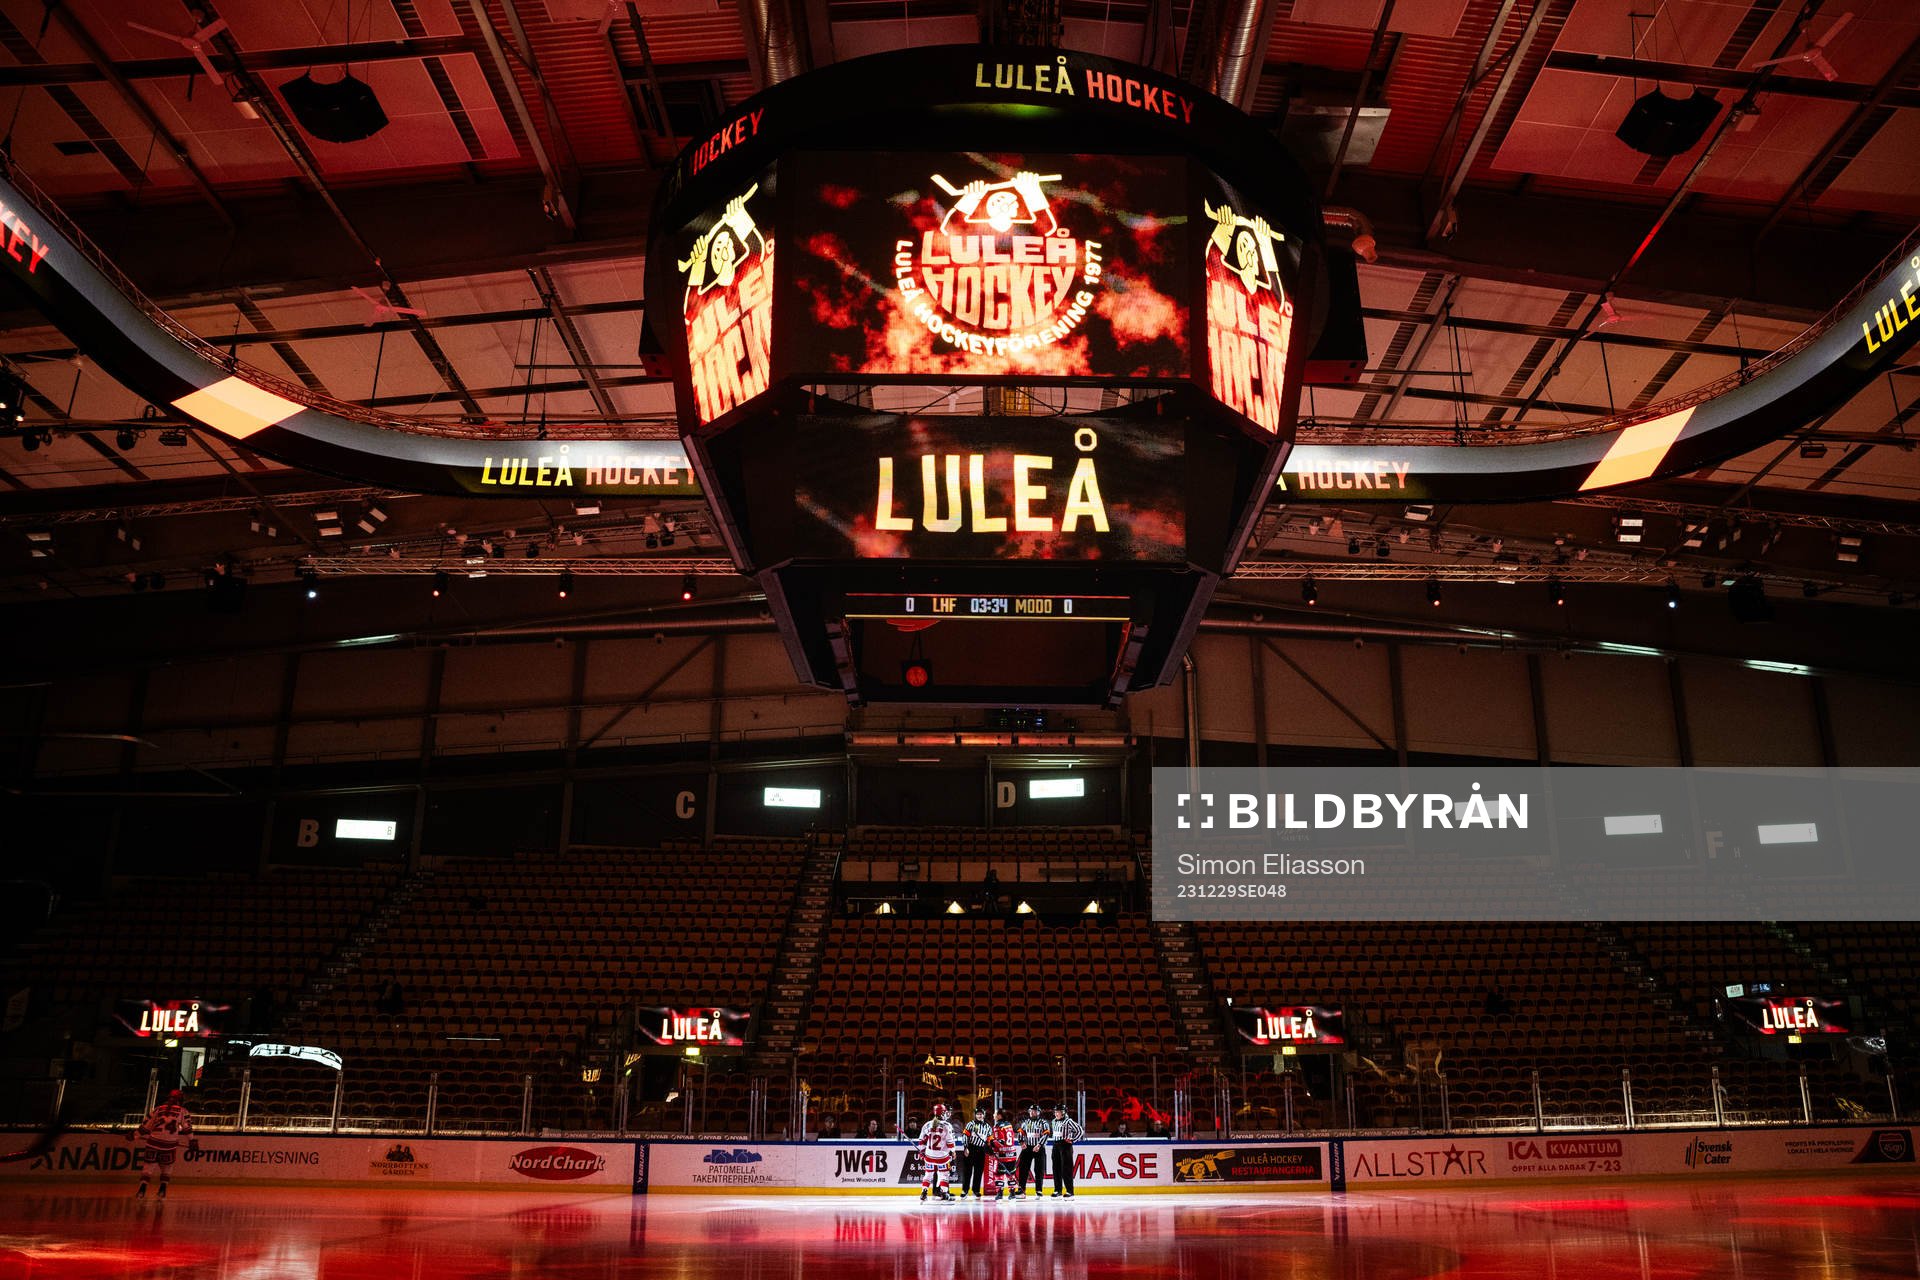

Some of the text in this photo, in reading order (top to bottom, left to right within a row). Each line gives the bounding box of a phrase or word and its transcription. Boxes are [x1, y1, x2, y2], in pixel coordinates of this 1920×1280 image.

[976, 56, 1195, 124] LULEÅ HOCKEY
[922, 228, 1077, 264] LULEÅ
[894, 240, 925, 302] LULEÅ
[1084, 240, 1102, 285] 1977
[922, 264, 1077, 330] HOCKEY
[481, 445, 695, 486] LULEÅ HOCKEY
[875, 428, 1110, 532] LULEÅ
[1297, 459, 1411, 490] HOCKEY
[906, 597, 1073, 613] 0 LHF 03:34 MODO 0
[675, 790, 696, 819] C
[997, 781, 1017, 808] D
[297, 817, 321, 848] B
[140, 1003, 199, 1032] LULEÅ
[661, 1010, 722, 1040] LULEÅ
[1256, 1009, 1317, 1039] LULEÅ
[1762, 1000, 1819, 1029] LULEÅ
[927, 1134, 942, 1151] 12
[1508, 1140, 1619, 1160] ICA KVANTUM
[1698, 1141, 1733, 1153] Svensk
[708, 1165, 756, 1175] PATOMELLA
[835, 1149, 888, 1178] JWAB
[1231, 1164, 1316, 1176] RESTAURANGERNA
[1242, 1152, 1303, 1165] LULEÅ HOCKEY
[1353, 1143, 1487, 1178] ALLSTAR
[1588, 1159, 1621, 1172] 7-23
[1704, 1154, 1731, 1165] Cater
